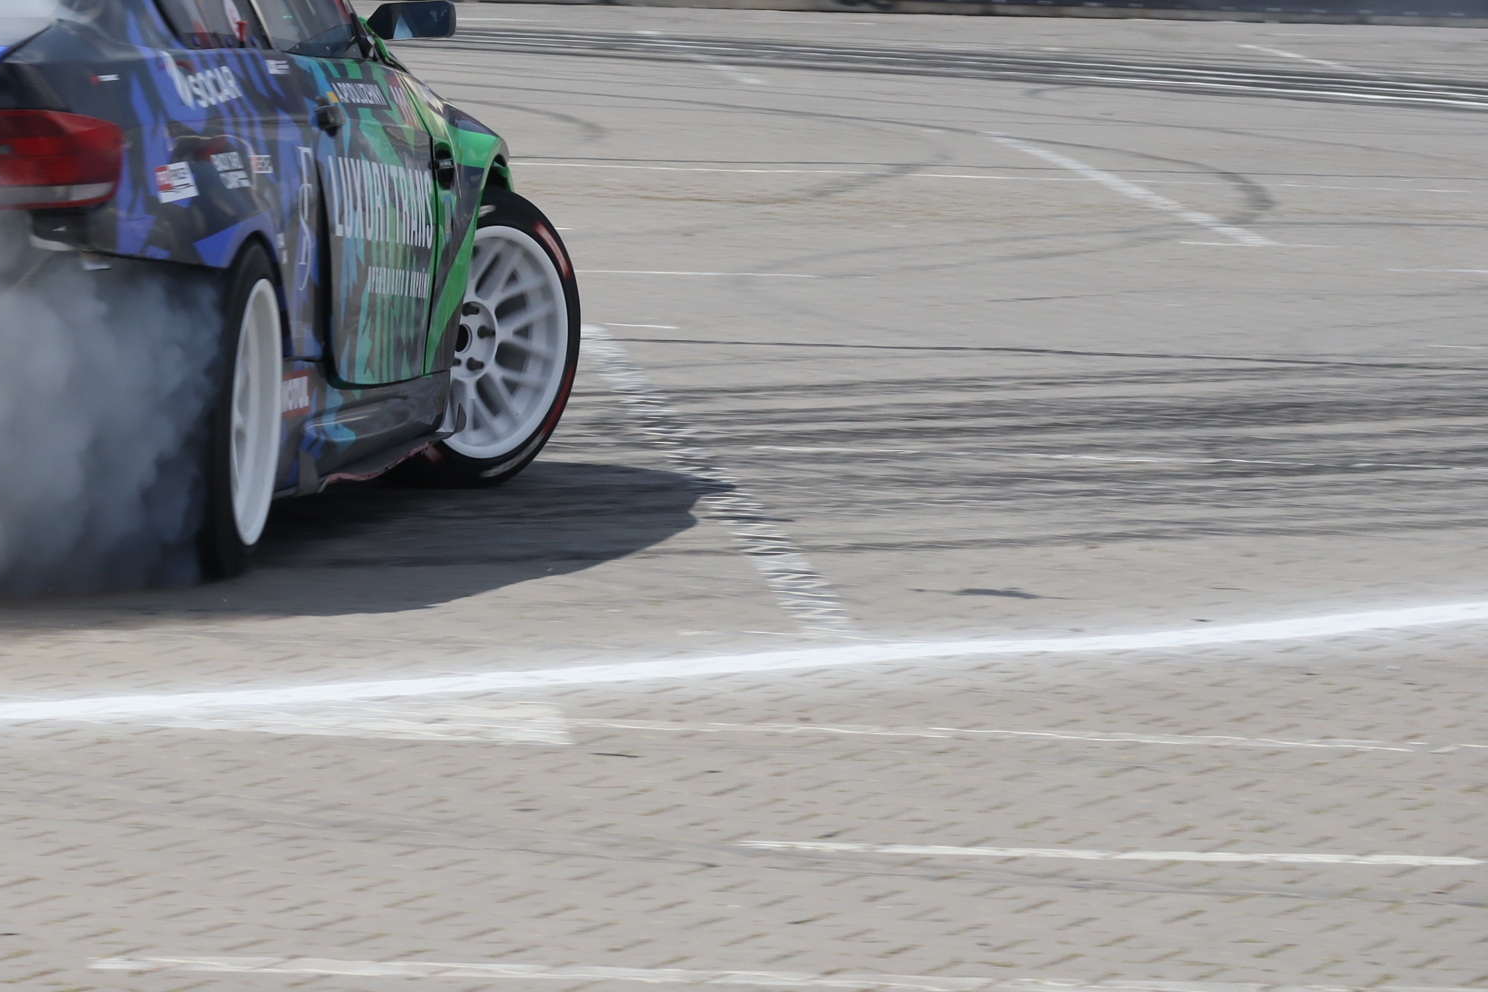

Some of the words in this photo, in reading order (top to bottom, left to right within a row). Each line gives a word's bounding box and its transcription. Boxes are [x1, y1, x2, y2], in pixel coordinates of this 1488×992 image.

[186, 64, 244, 109] SOCAR
[328, 154, 391, 242] LUXURY
[389, 164, 434, 250] TRANS
